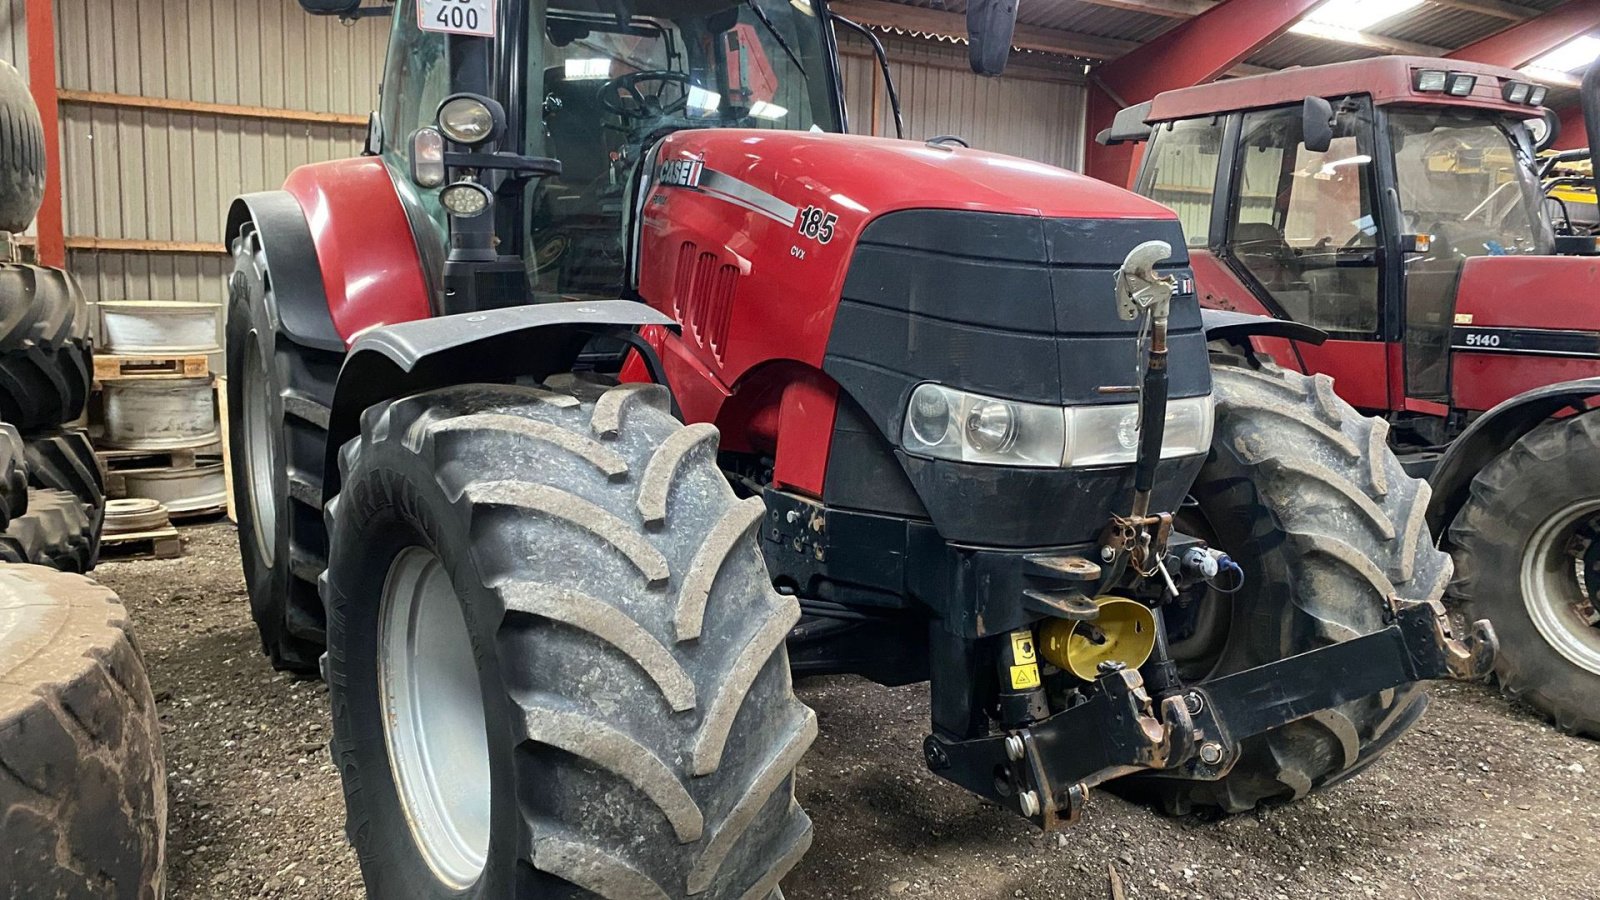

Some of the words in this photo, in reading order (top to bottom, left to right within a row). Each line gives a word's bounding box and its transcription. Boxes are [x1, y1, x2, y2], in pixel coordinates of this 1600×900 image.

[436, 5, 478, 30] 400
[798, 204, 839, 245] 185
[790, 245, 806, 260] CVX
[1465, 333, 1500, 346] 5140
